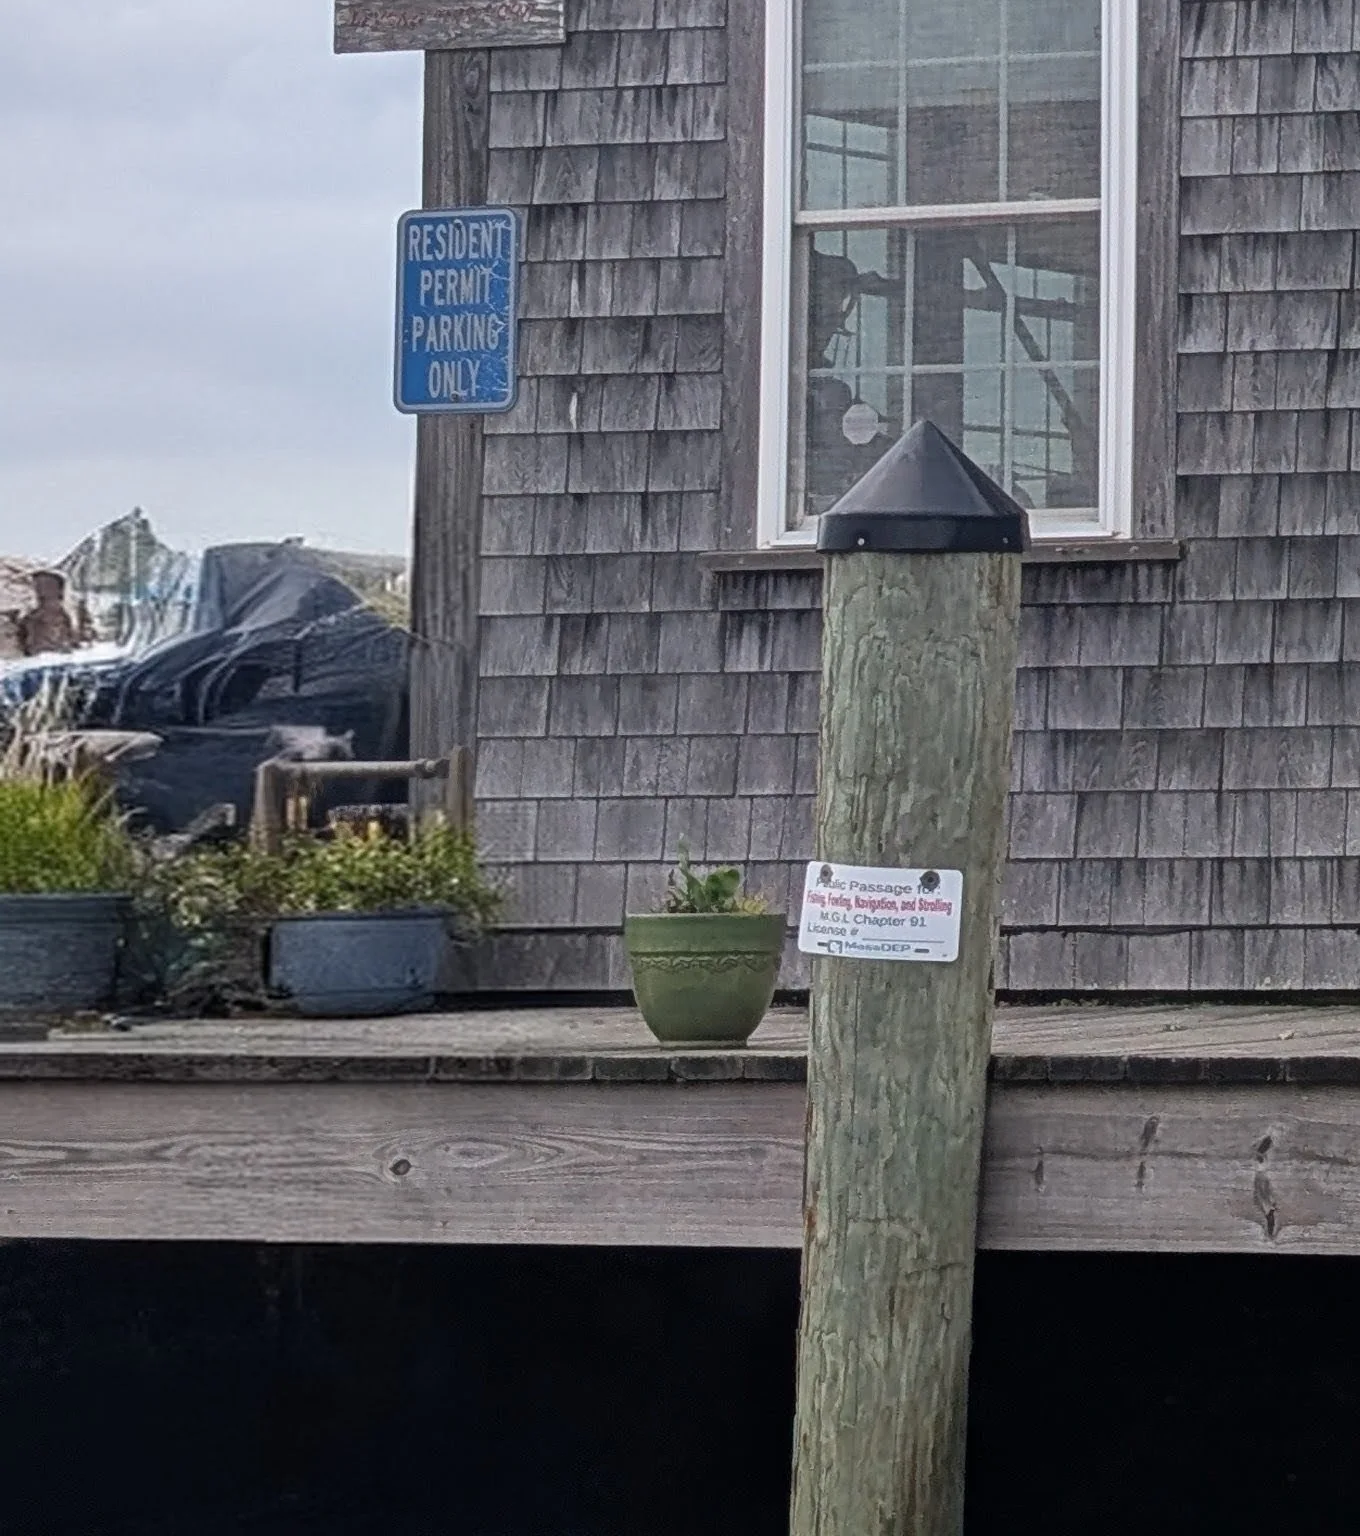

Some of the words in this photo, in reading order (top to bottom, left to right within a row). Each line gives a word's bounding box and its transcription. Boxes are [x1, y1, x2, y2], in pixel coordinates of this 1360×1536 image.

[408, 221, 504, 262] RESIDENT
[420, 268, 493, 307] PERMIT
[411, 314, 500, 353] PARKING
[428, 360, 482, 399] ONLY
[849, 880, 913, 896] Passage
[853, 913, 906, 928] Chapter
[910, 915, 927, 927] 91
[901, 897, 916, 911] and
[918, 897, 953, 916] Strolling
[807, 922, 847, 937] License
